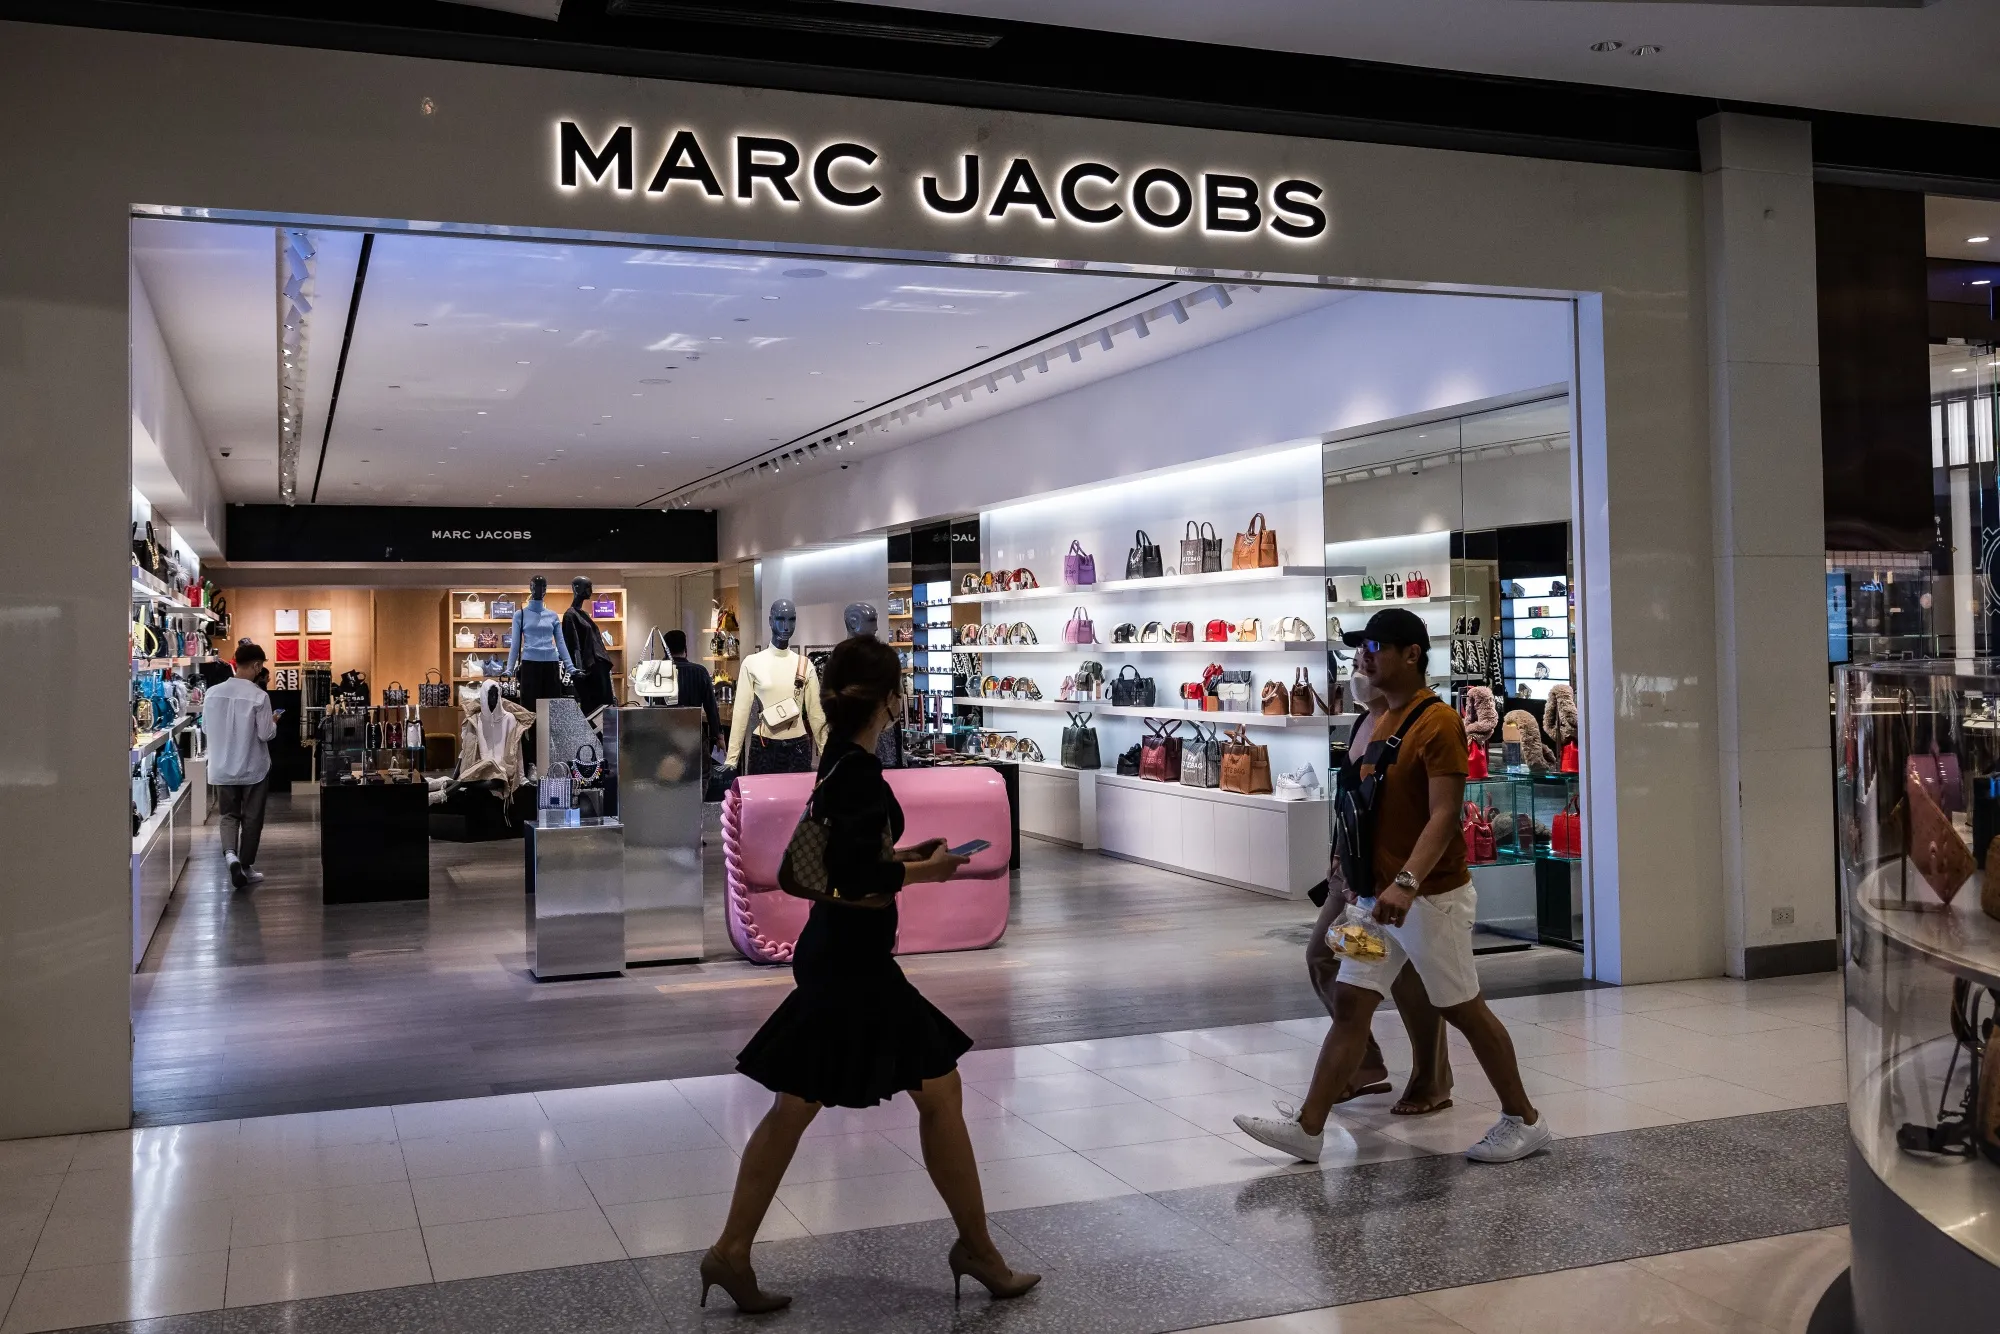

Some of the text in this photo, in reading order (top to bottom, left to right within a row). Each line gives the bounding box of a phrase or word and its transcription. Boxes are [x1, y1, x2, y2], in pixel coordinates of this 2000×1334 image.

[557, 121, 1328, 239] MARC JACOBS
[431, 530, 532, 540] MARC JACOBS
